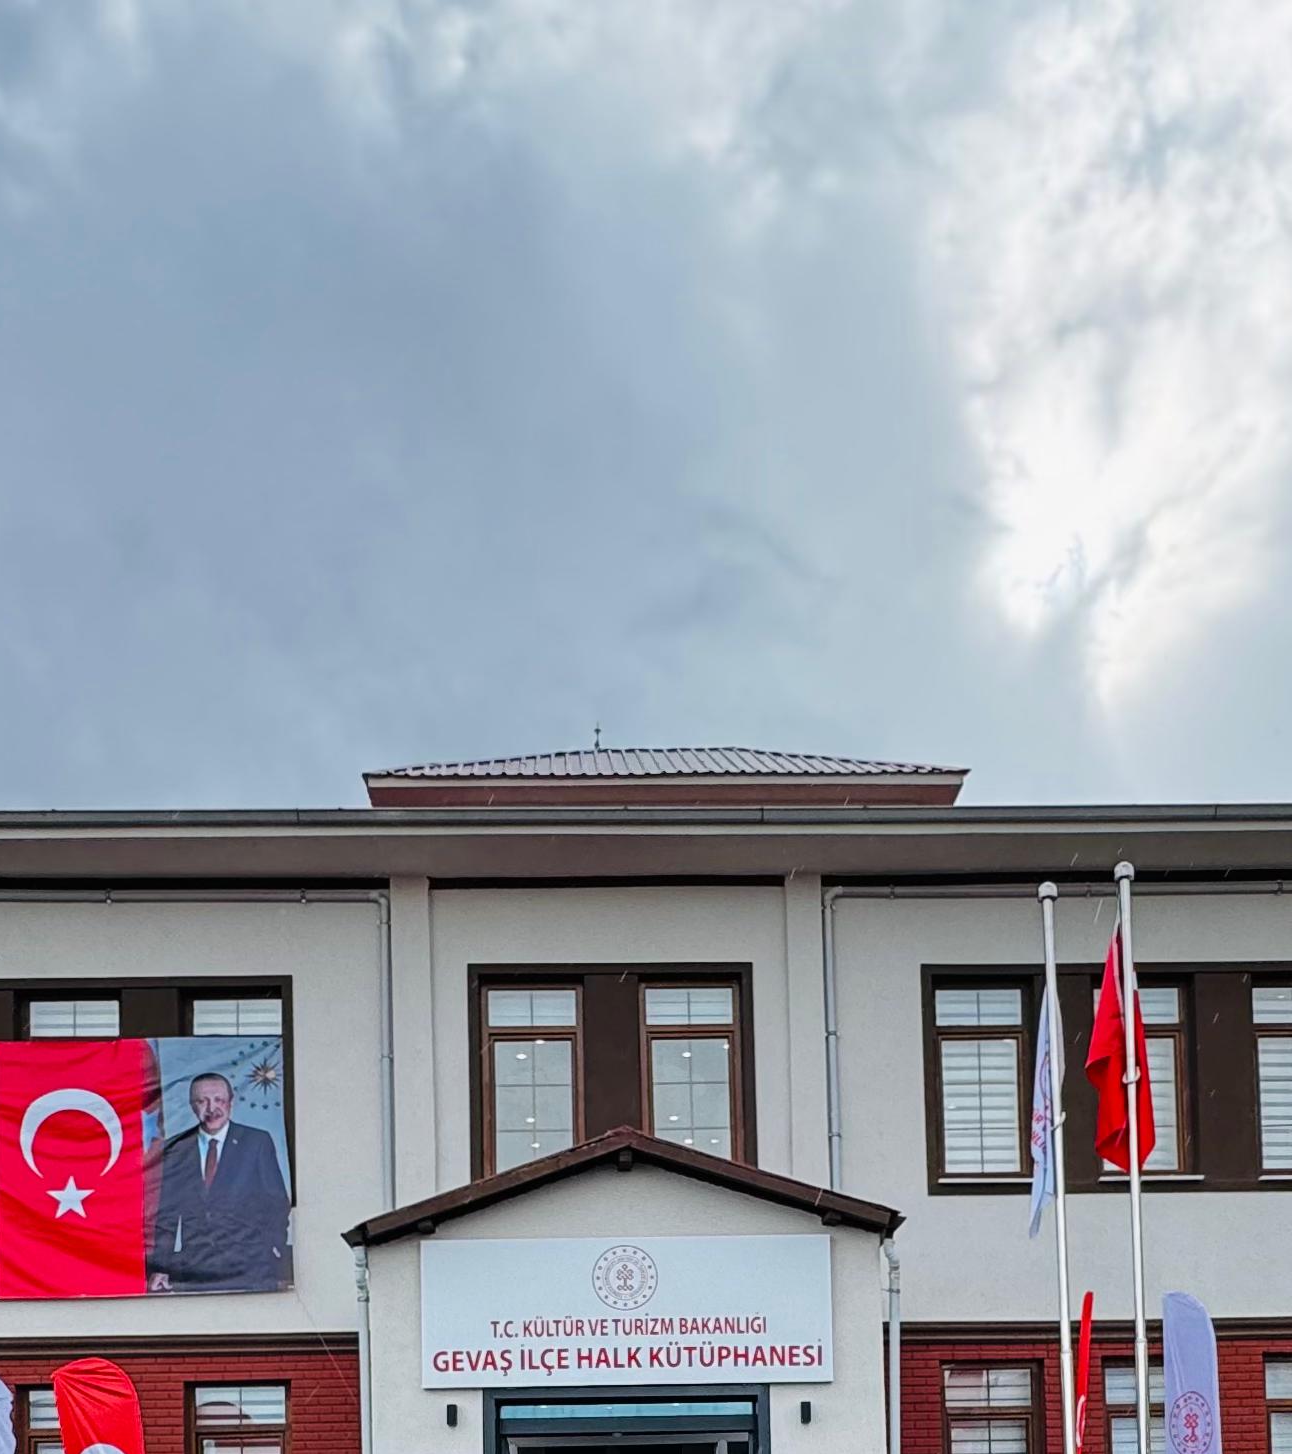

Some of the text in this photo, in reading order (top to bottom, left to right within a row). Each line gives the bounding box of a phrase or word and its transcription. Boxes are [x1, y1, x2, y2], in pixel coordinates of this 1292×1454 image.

[491, 1312, 767, 1338] T.C. KÜLTÜR VE TURİZM BAKANLIĞI
[433, 1338, 823, 1377] GEVAŞ İLÇE HALK KÜTÜPHANESİ
